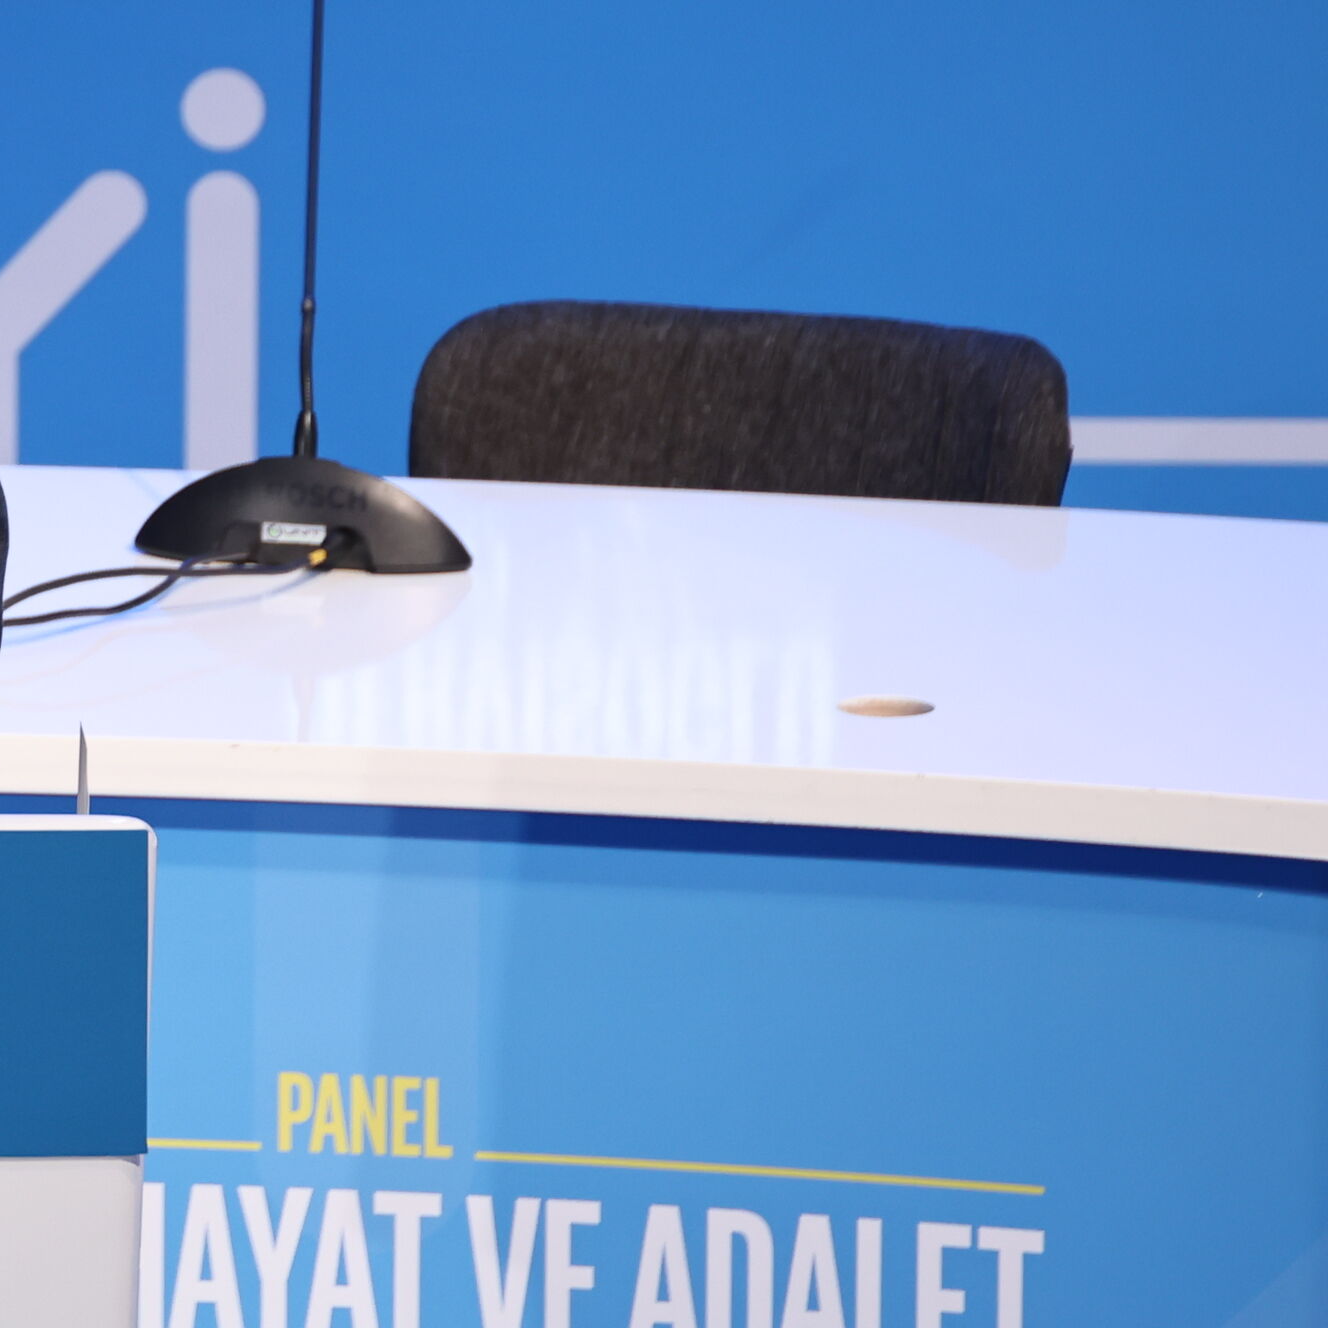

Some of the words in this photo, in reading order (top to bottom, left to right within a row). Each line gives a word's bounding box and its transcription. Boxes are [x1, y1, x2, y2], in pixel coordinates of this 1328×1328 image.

[277, 1071, 454, 1160] PANEL
[465, 1194, 602, 1328] VE
[629, 1203, 1045, 1328] ADALET
